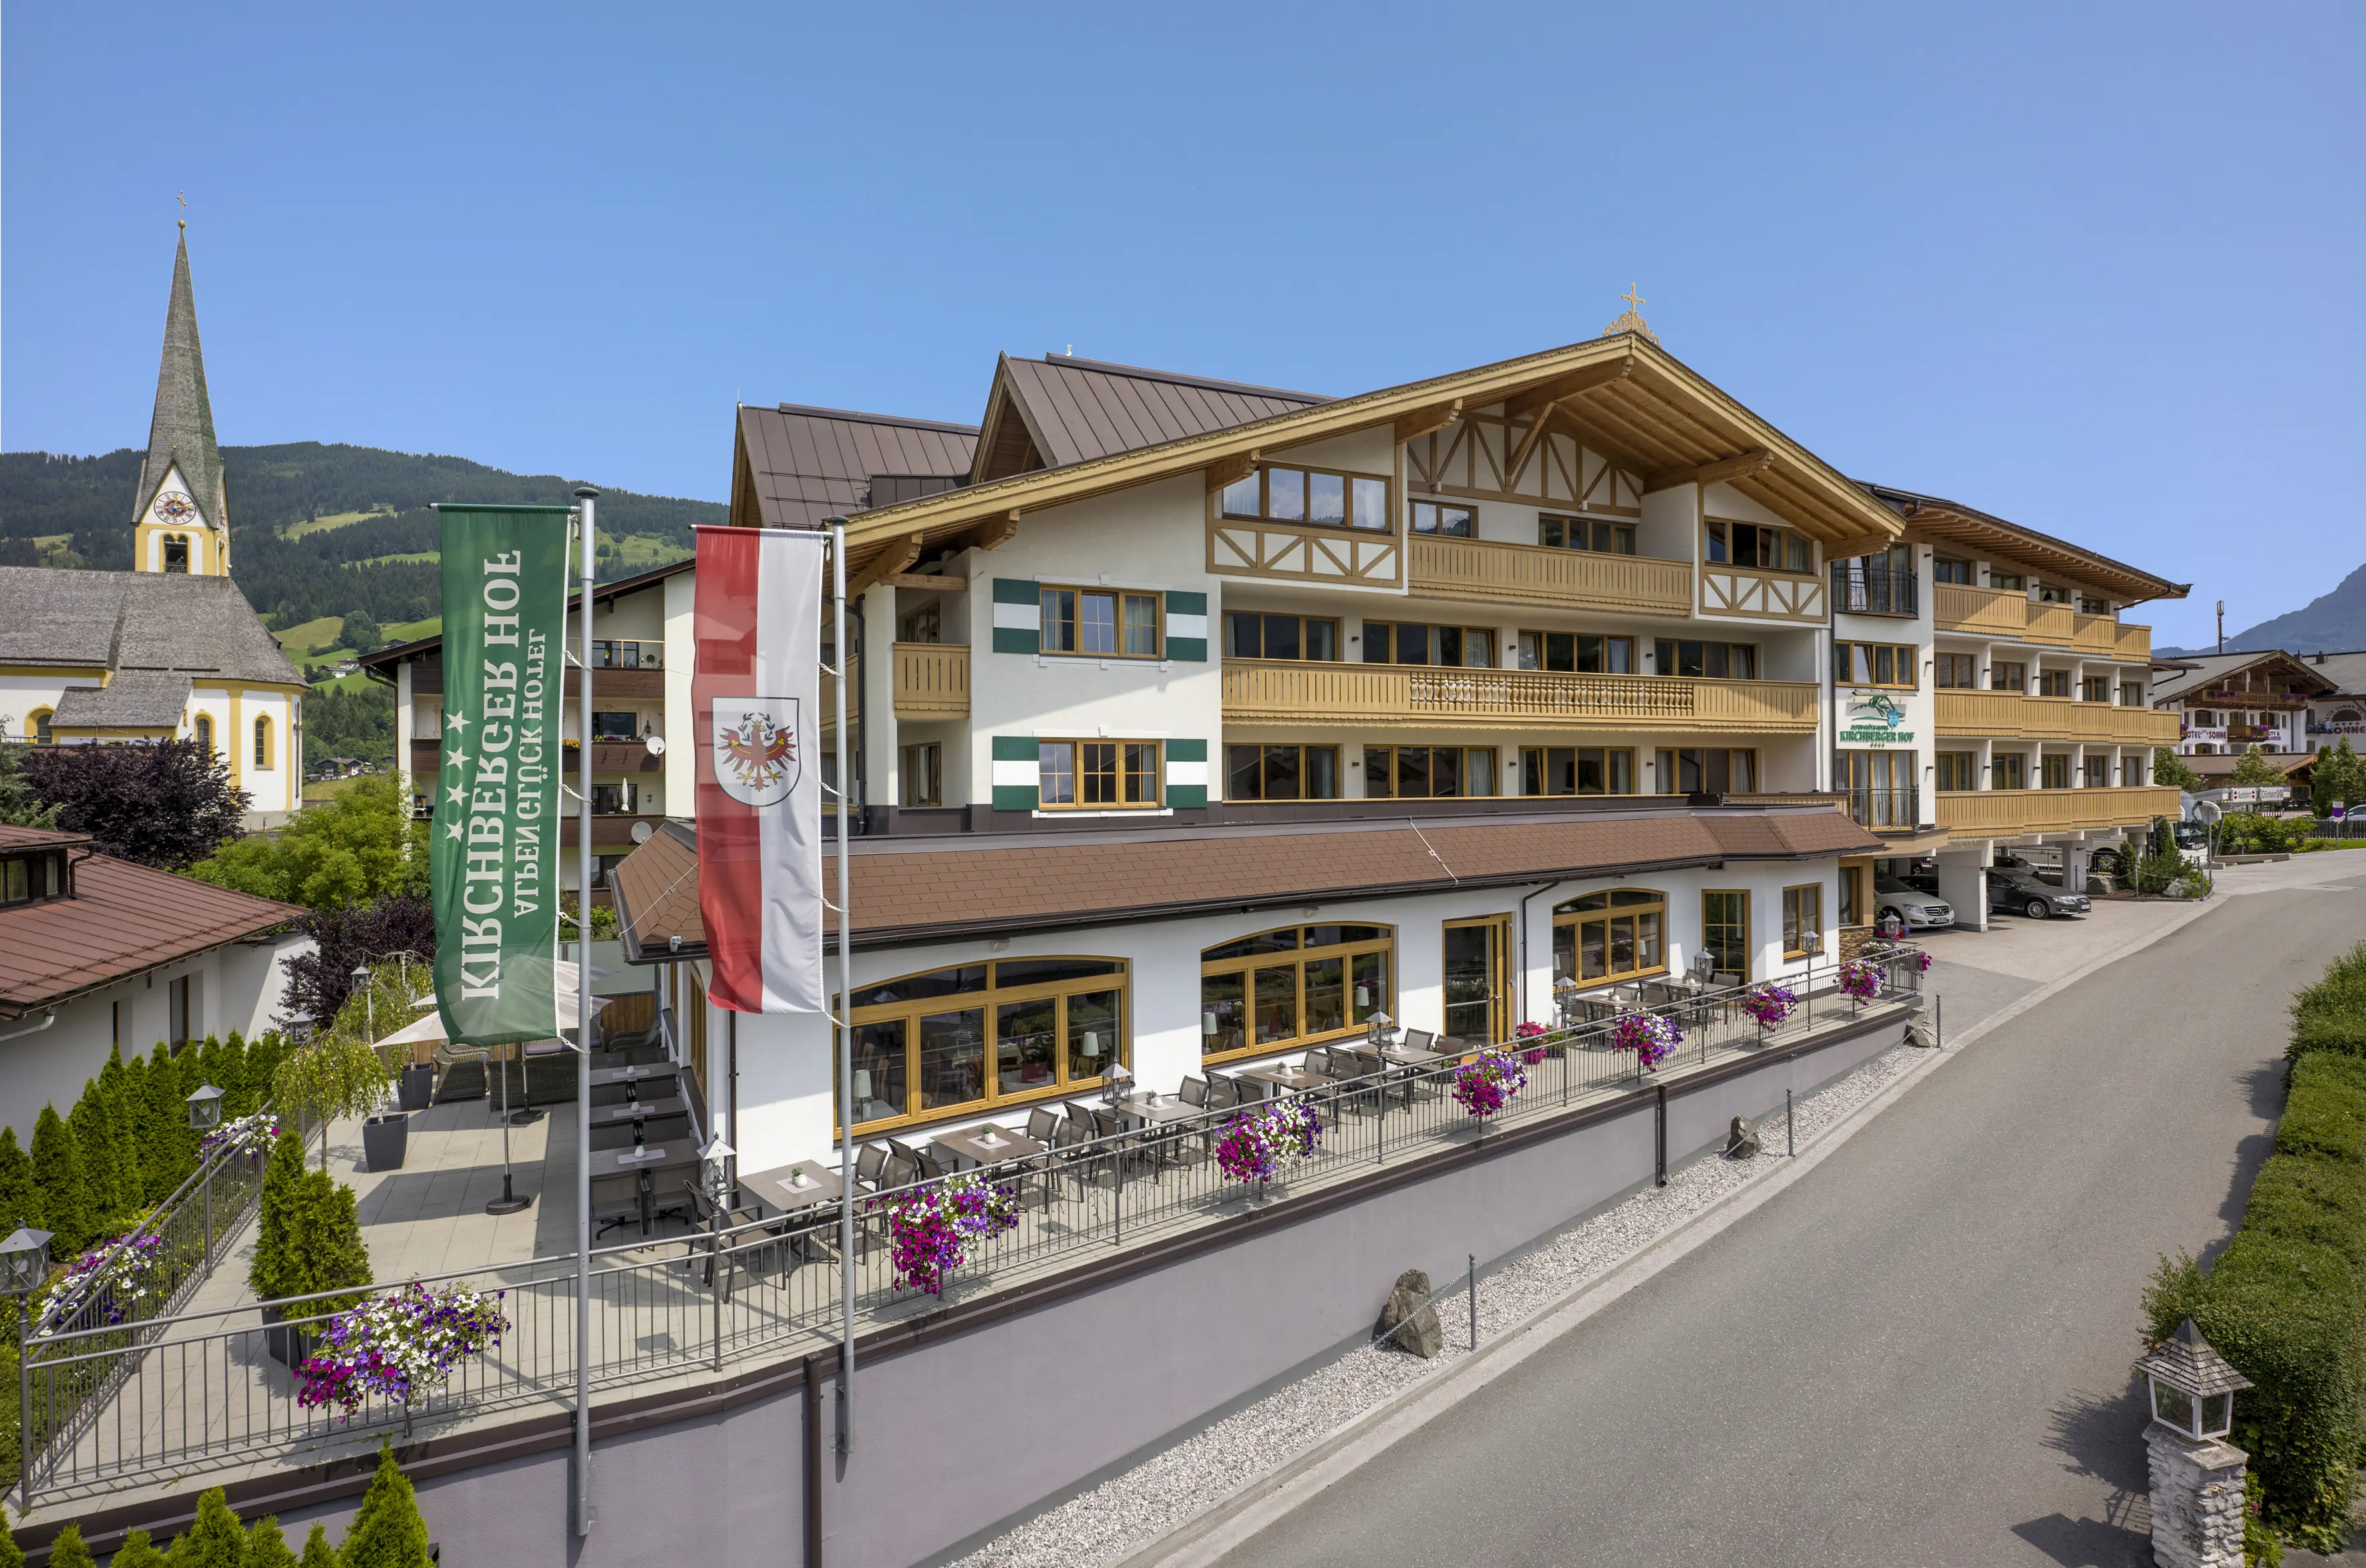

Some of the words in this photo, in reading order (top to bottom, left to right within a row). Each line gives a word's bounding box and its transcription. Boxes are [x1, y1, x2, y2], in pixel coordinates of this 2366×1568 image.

[2325, 709, 2334, 720] CTIV
[2333, 725, 2365, 734] ONNE
[1840, 731, 1896, 741] KIRCHBERGER
[1898, 732, 1914, 741] HOF
[2186, 731, 2201, 739] OTEL
[2208, 731, 2226, 739] SONNE
